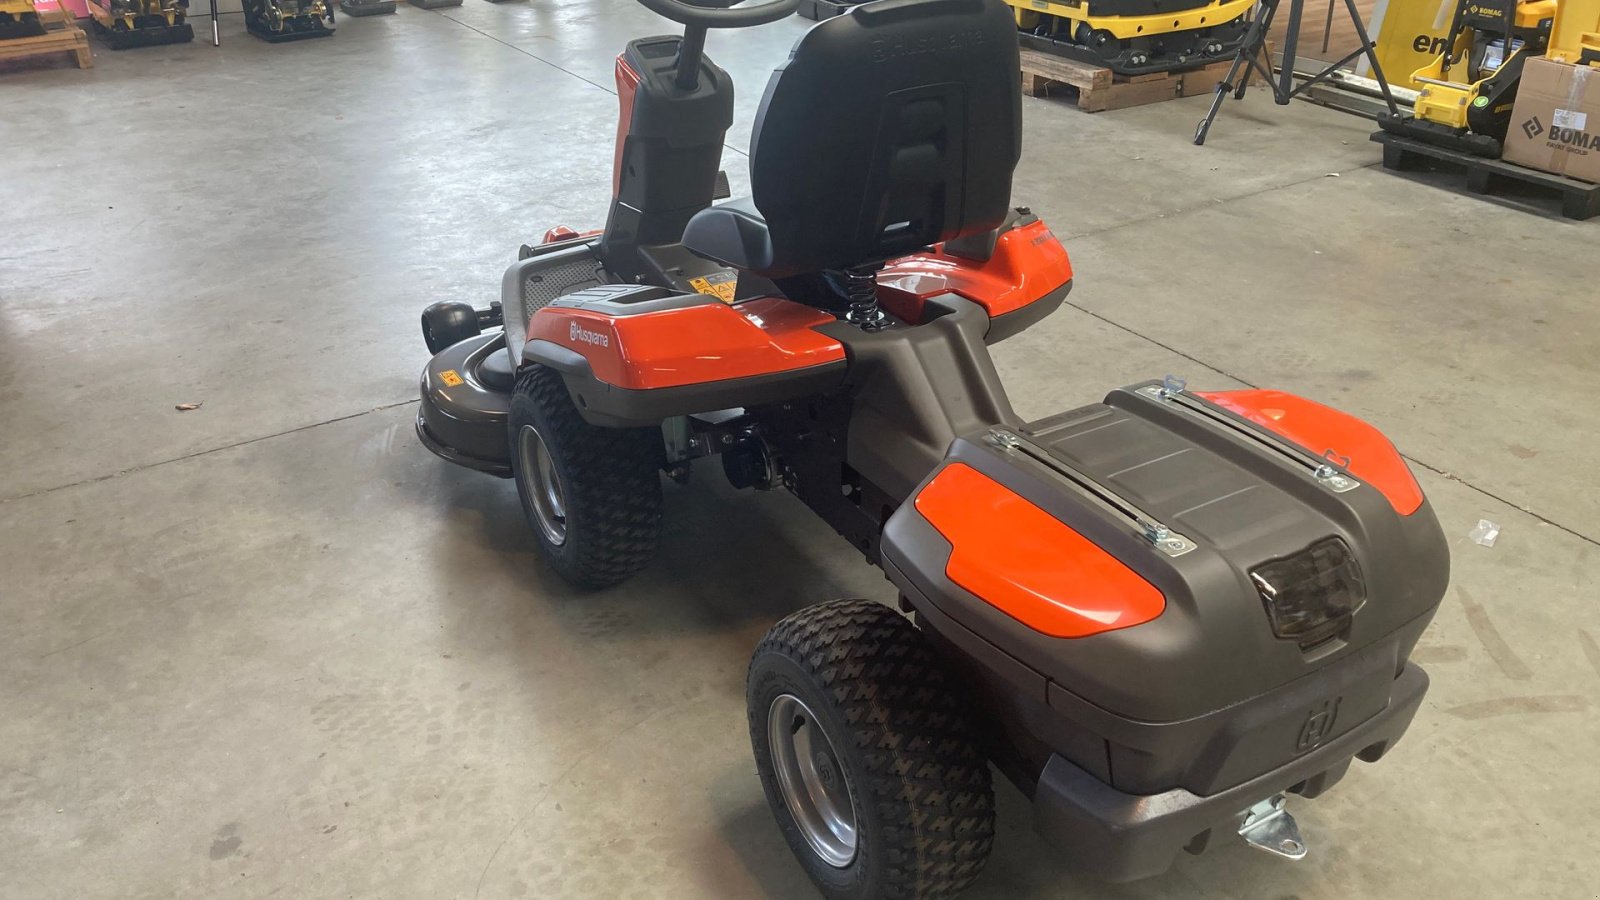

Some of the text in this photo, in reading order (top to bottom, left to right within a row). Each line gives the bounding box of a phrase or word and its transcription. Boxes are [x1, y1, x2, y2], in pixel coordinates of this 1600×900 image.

[1479, 7, 1503, 17] BOMAG
[1546, 141, 1589, 156] FAYAT GROUP
[576, 324, 609, 348] Husqvarna
